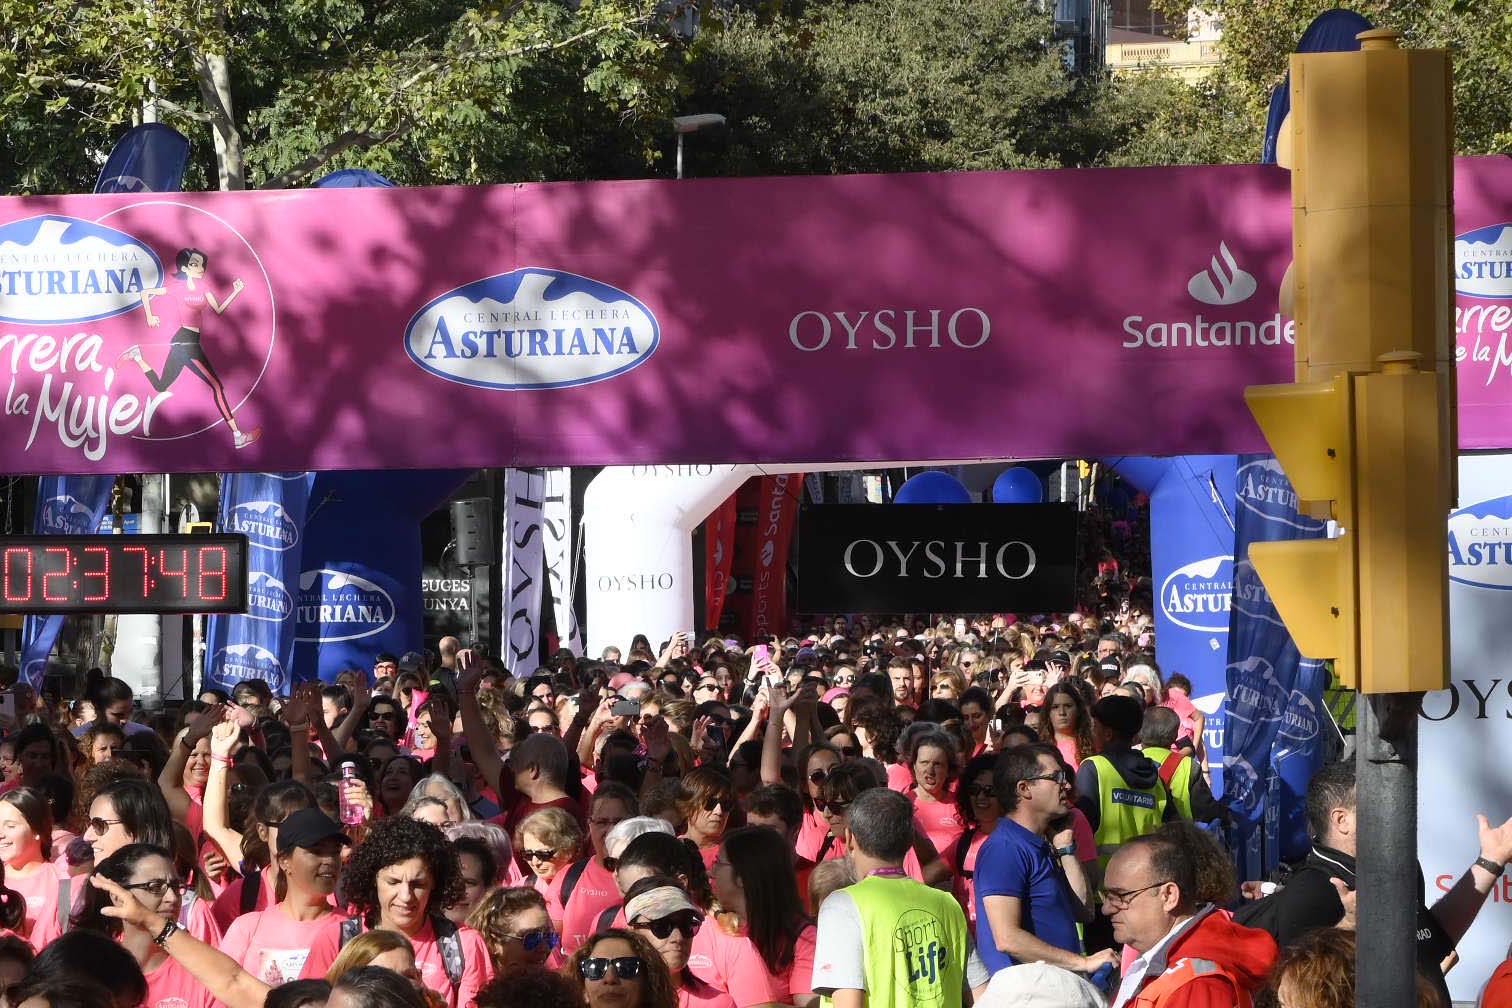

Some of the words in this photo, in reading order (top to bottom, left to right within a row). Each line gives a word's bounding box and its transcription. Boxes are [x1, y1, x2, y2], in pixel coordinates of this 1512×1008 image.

[463, 310, 542, 323] CENTRAL
[550, 306, 632, 321] LECHERA
[789, 307, 991, 352] OYSHO
[424, 315, 640, 359] ASTURIANA
[5, 376, 29, 416] la
[24, 366, 173, 462] Mujer
[5, 546, 226, 602] 02:37:48
[844, 539, 1037, 580] OYSHO
[598, 572, 674, 593] OYSHO
[1184, 582, 1233, 591] CENTRAL
[895, 918, 939, 952] Sport
[906, 941, 947, 985] Life
